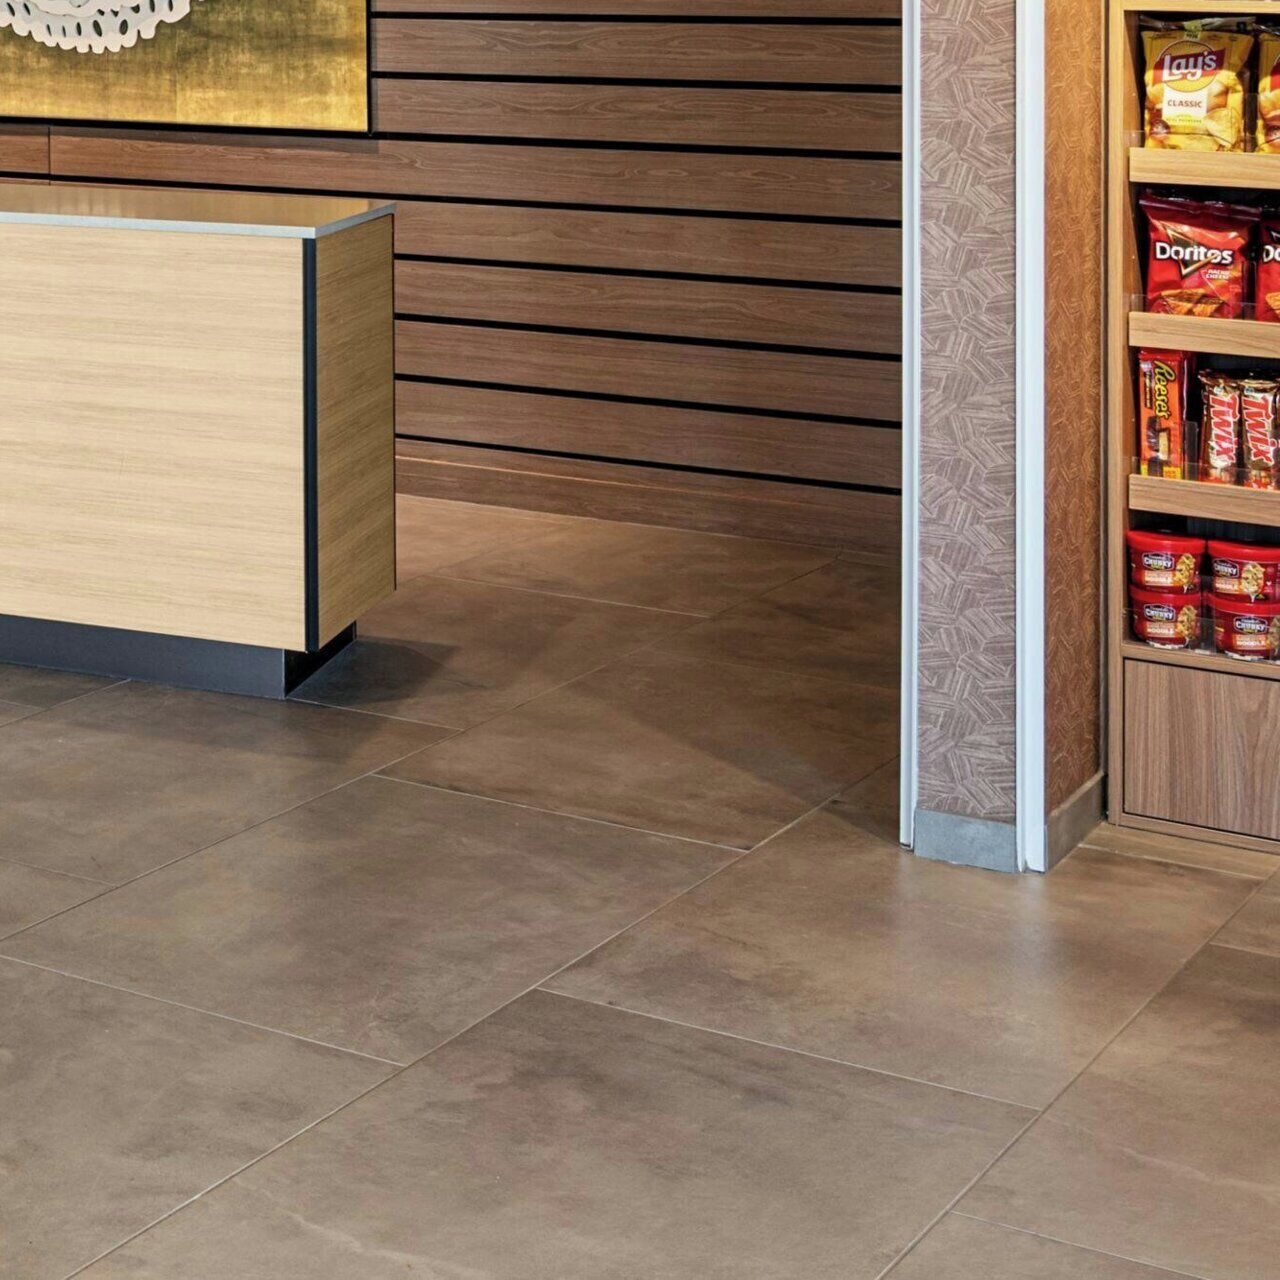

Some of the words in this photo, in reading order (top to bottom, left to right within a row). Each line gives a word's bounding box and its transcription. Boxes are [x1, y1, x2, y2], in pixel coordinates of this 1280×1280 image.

[1162, 50, 1217, 81] Lay's
[1167, 99, 1202, 108] CLASSIC
[1155, 241, 1234, 264] Doritos
